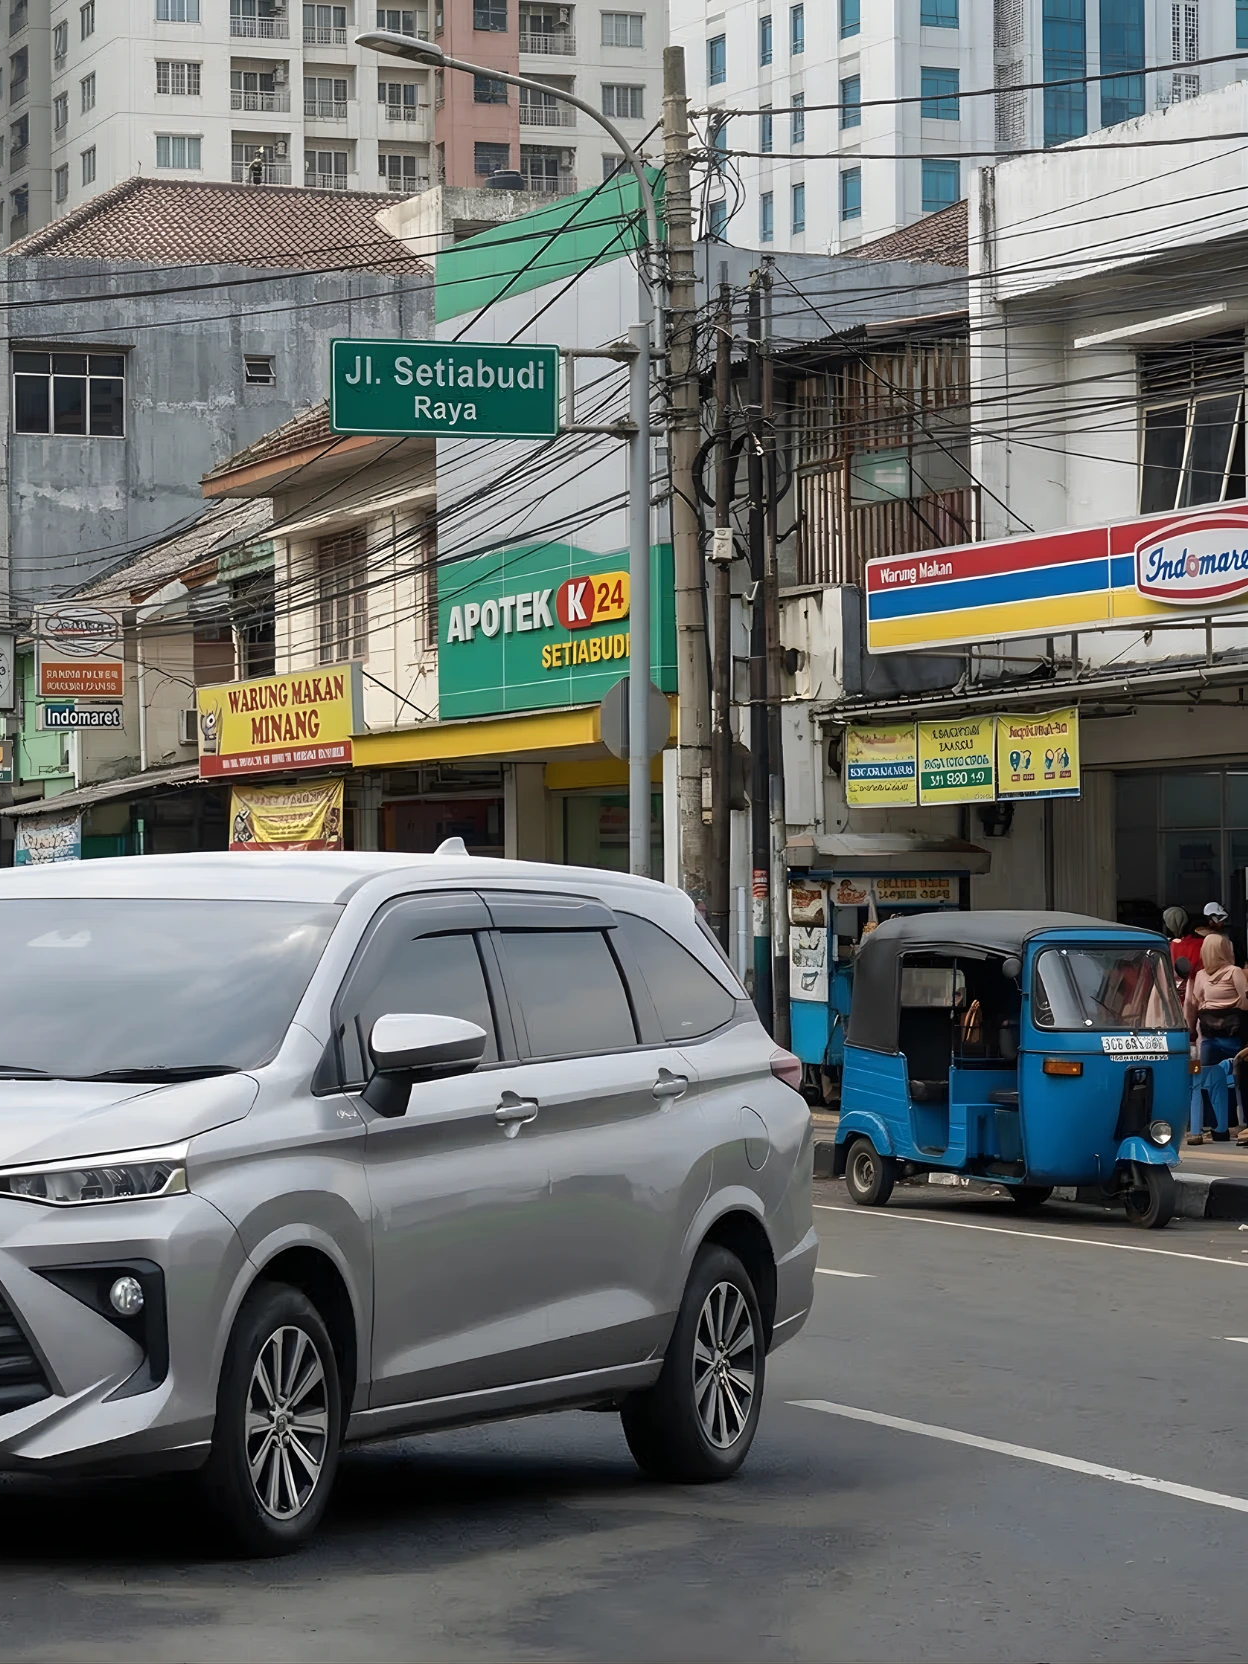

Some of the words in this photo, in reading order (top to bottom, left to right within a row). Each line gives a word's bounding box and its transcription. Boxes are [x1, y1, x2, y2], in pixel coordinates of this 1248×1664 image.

[345, 356, 381, 385] Jl.
[394, 357, 545, 389] Setiabudi
[414, 395, 477, 426] Raya
[447, 588, 554, 644] APOTEK
[228, 682, 288, 714] WARUNG
[291, 674, 345, 706] MAKAN
[47, 707, 120, 725] Indomaret
[251, 709, 320, 745] MINANG
